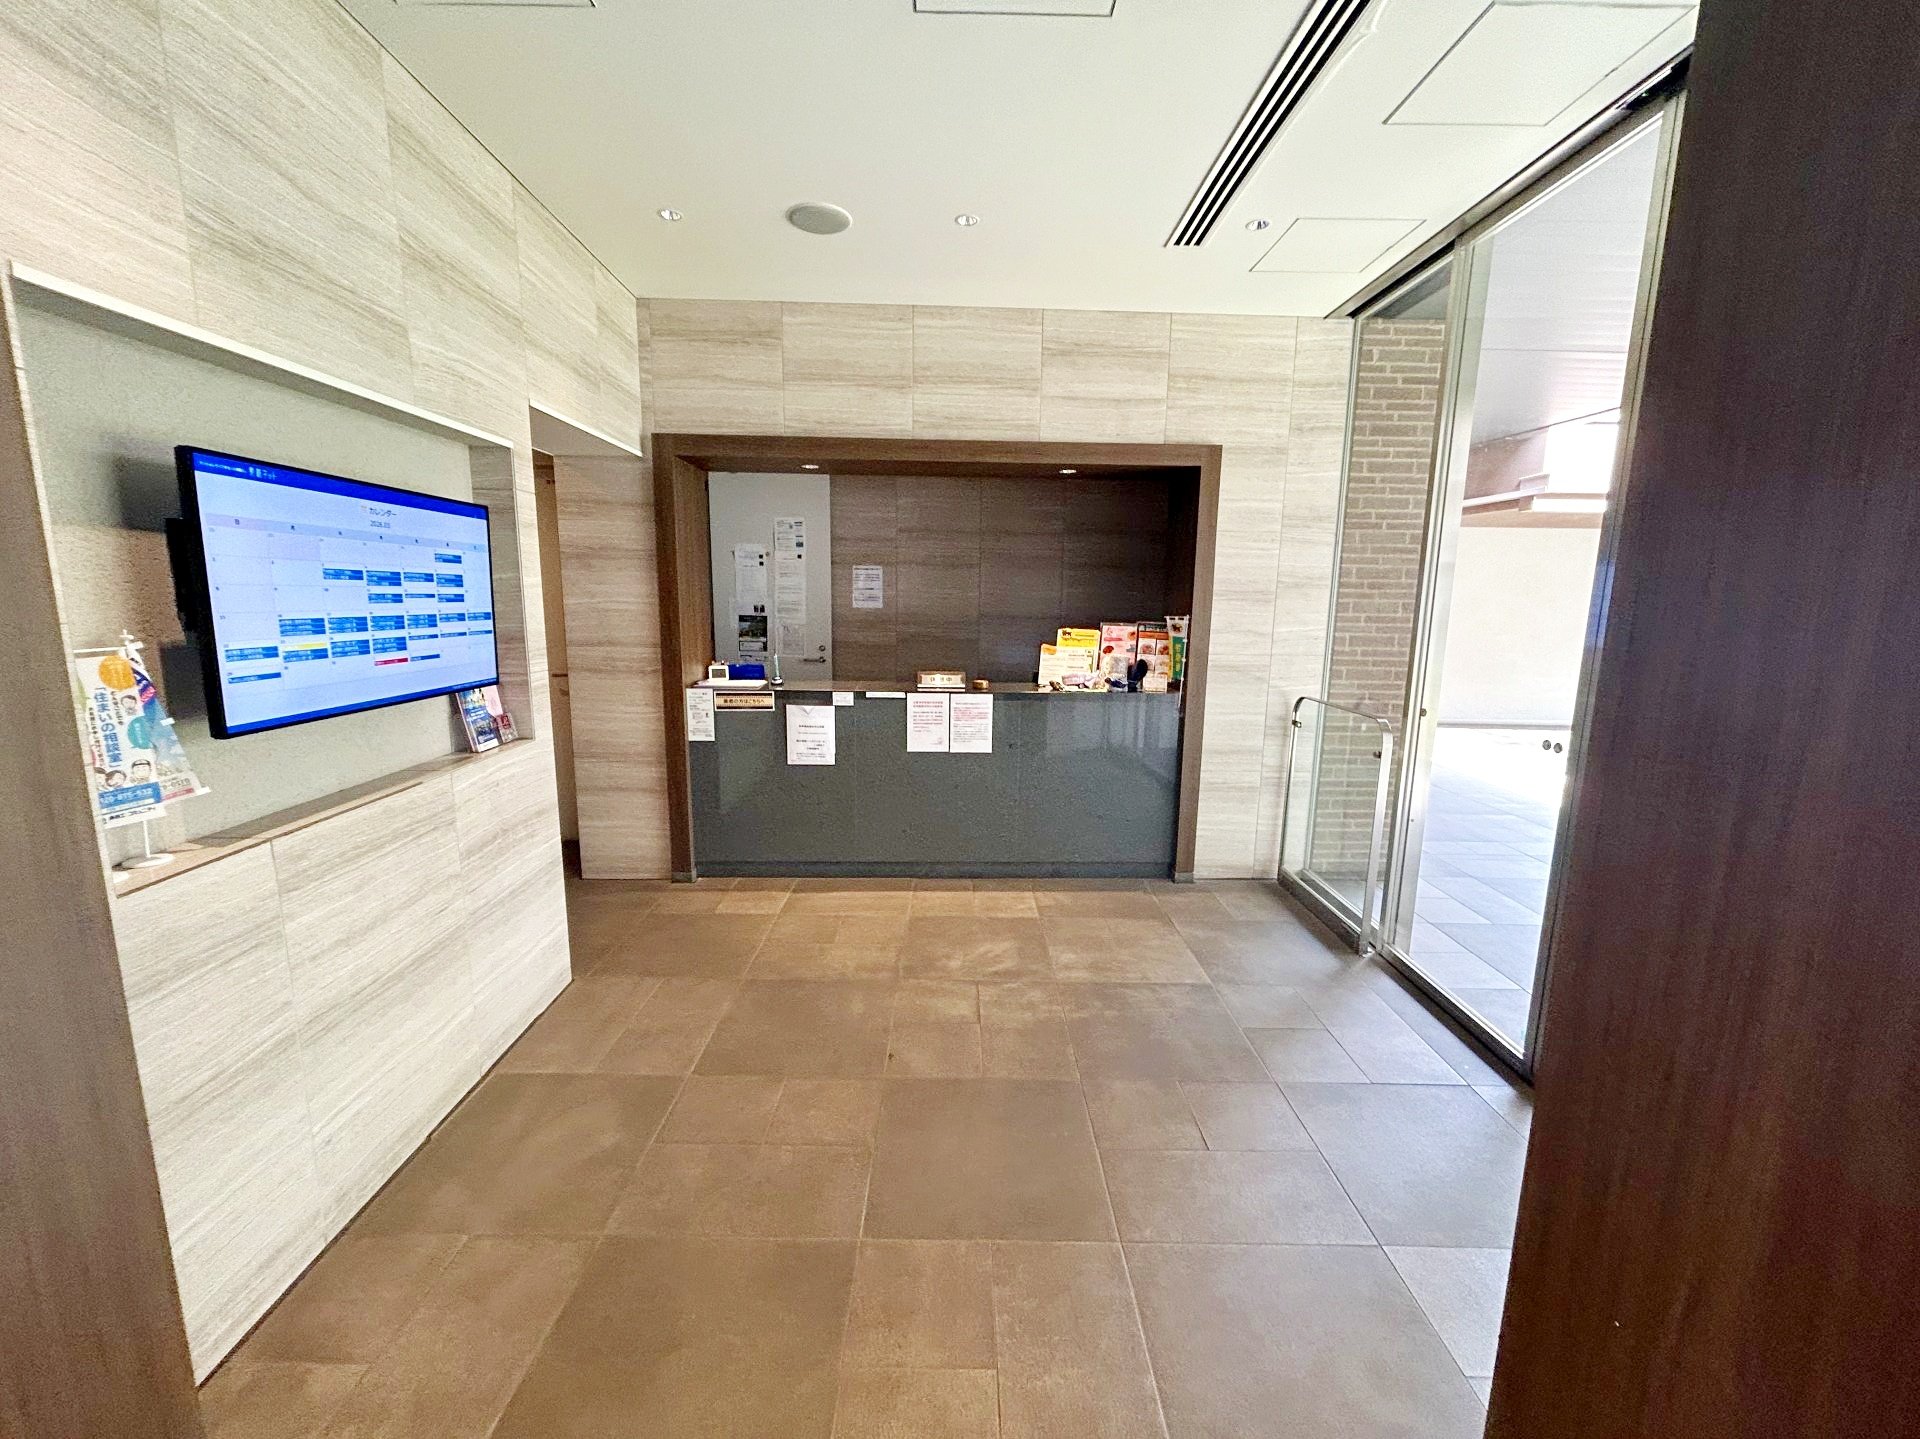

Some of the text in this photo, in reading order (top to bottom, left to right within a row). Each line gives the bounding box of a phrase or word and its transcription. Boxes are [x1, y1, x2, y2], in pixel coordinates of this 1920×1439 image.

[369, 507, 397, 518] カレンダー
